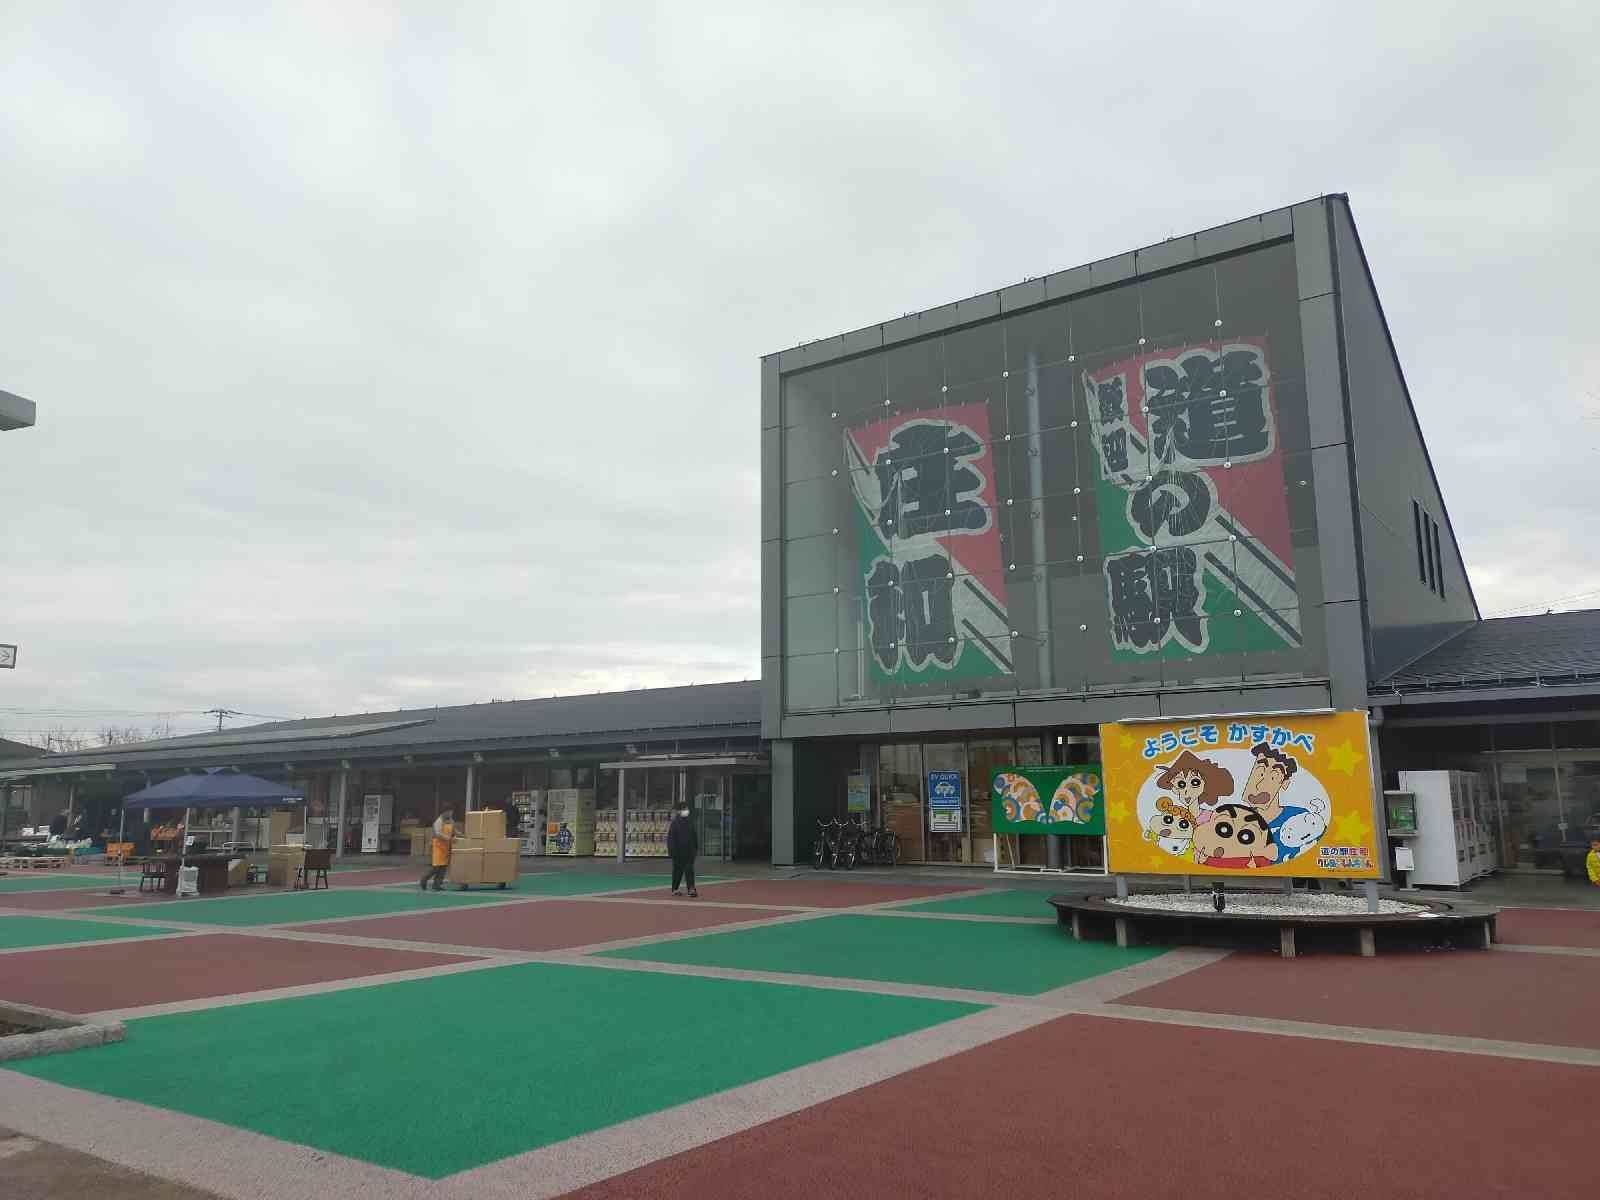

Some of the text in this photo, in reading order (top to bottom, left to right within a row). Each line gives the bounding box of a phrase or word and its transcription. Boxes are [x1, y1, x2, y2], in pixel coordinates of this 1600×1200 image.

[865, 418, 992, 675] 庄和
[1102, 345, 1276, 653] 道の駅
[1143, 724, 1314, 758] ようこそ かすかべ
